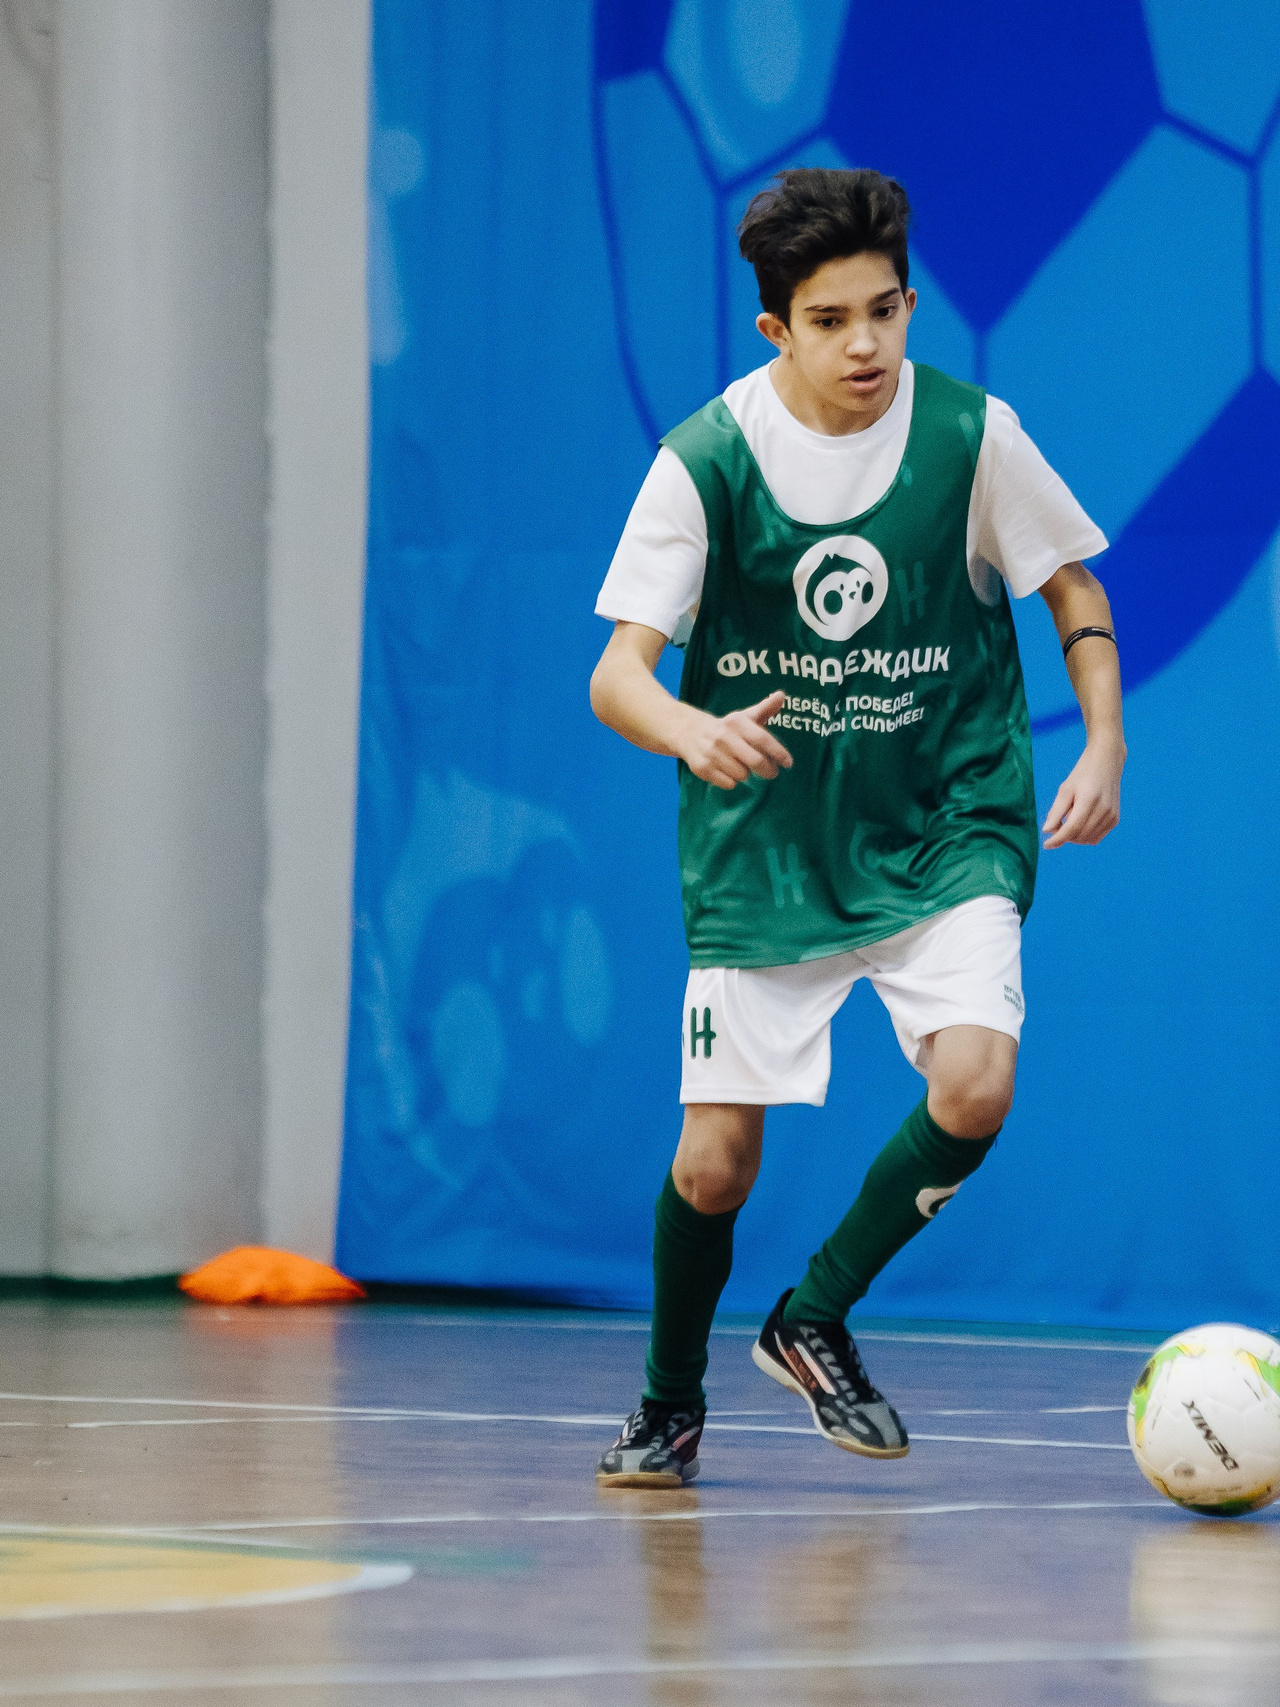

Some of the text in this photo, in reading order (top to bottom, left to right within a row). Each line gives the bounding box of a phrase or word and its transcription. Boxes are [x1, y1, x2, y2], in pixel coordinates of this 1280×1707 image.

[717, 646, 951, 687] ФК НАДЕЖДИК
[767, 712, 821, 735] МЕСТЕ
[851, 706, 925, 733] СИЛЬНЕЕ!
[782, 695, 831, 722] ПЕРЁД
[845, 691, 914, 715] ПОБЕДЕ!
[690, 1006, 717, 1060] Н
